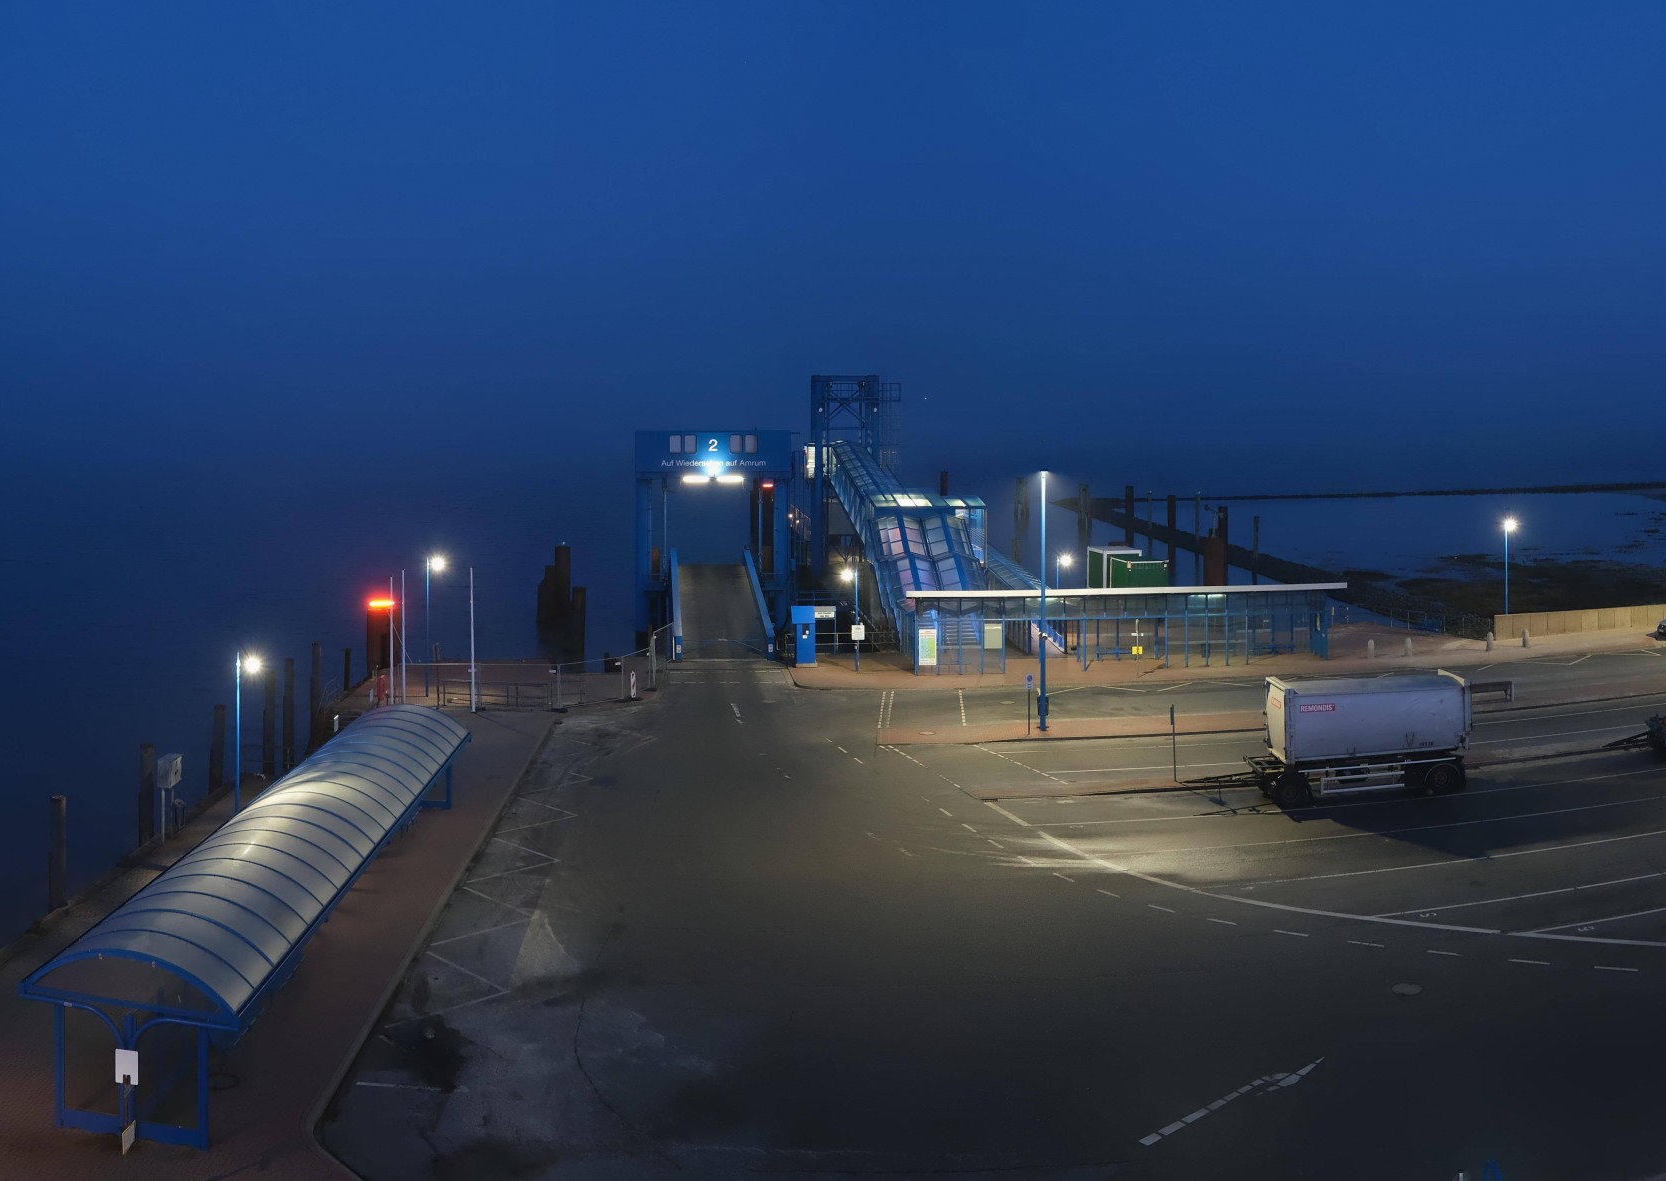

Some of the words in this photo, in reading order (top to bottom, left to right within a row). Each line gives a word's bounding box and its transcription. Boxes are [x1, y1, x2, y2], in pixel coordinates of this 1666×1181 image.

[708, 438, 718, 452] 2
[661, 459, 674, 467] Auf
[675, 459, 724, 467] Wiedersn
[725, 459, 737, 467] auf
[739, 459, 767, 467] Amrum
[1300, 703, 1333, 712] REMONDIS
